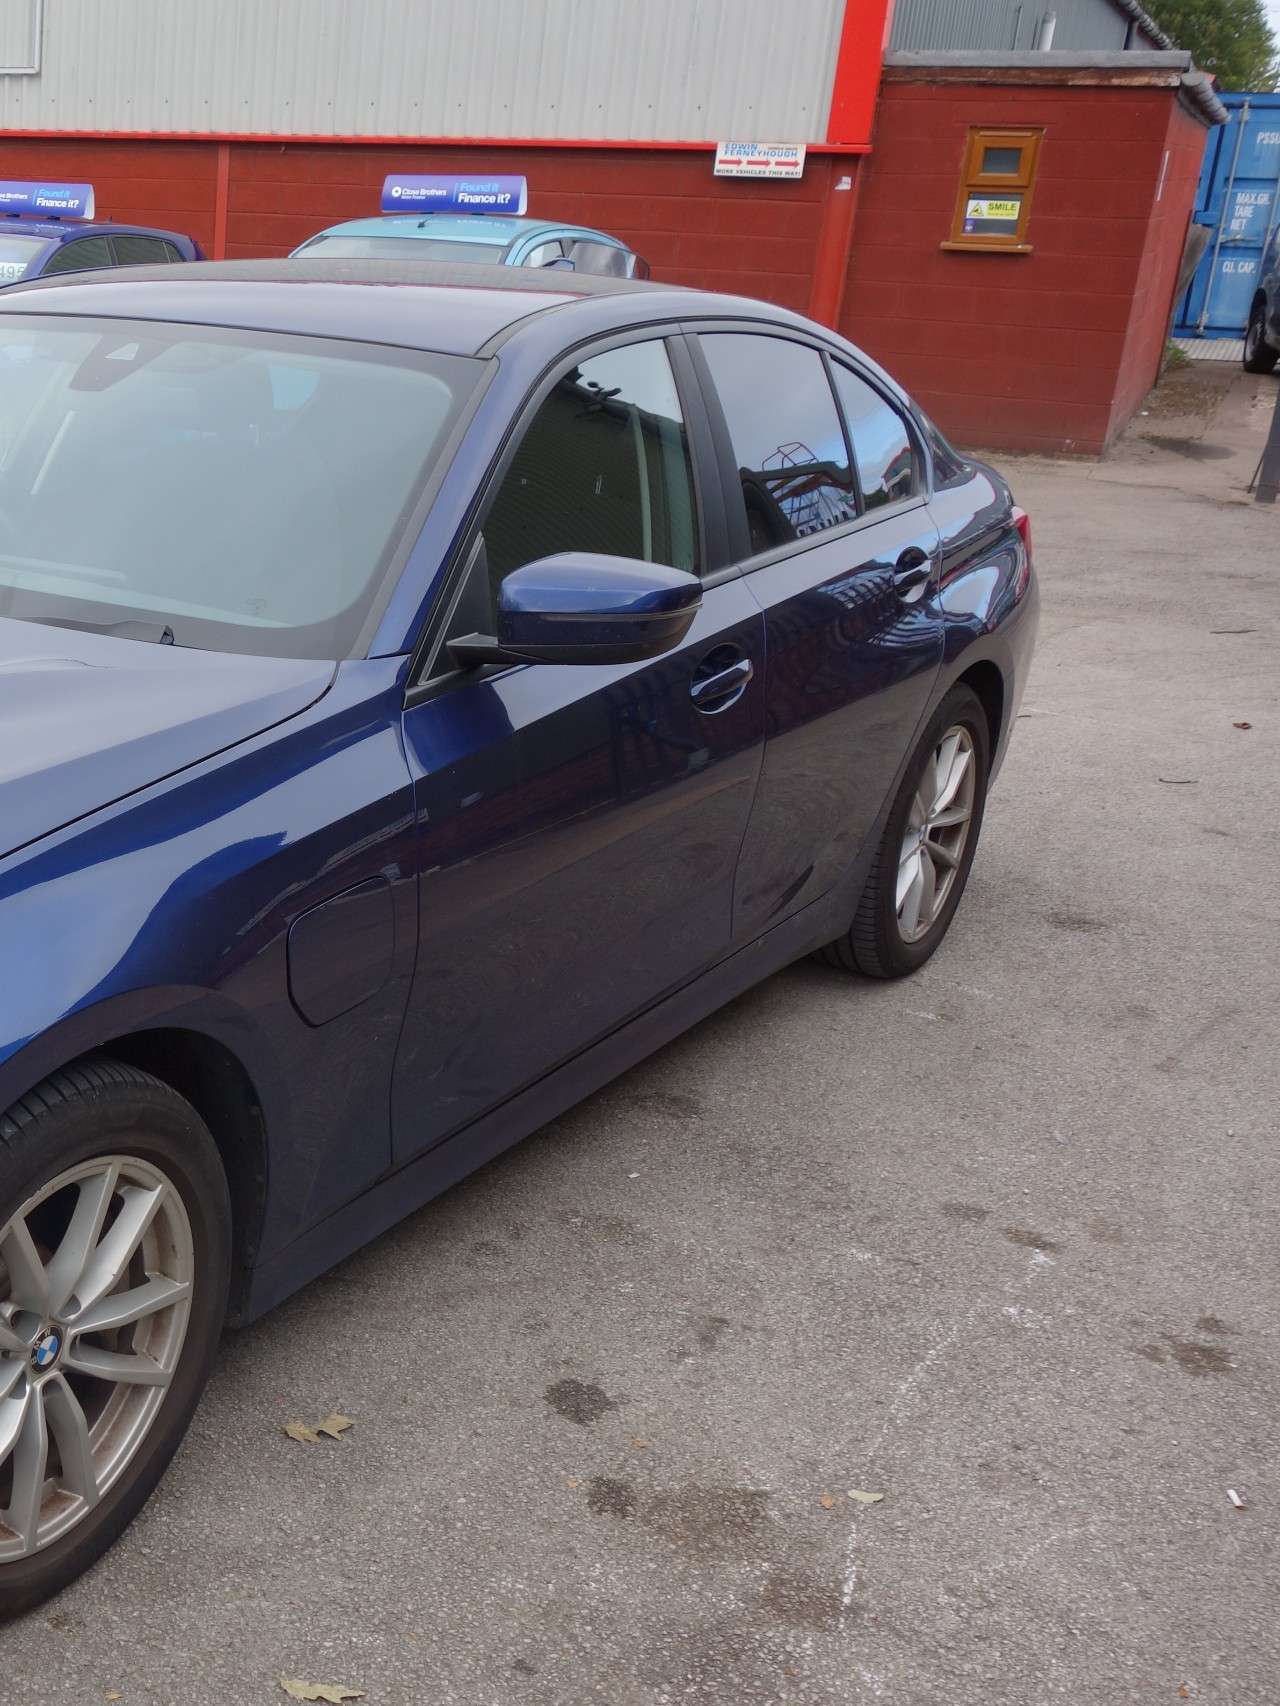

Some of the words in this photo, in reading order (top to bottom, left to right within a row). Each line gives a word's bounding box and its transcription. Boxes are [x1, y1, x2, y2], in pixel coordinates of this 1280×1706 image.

[724, 149, 798, 158] FERNEYHOUGH
[460, 182, 489, 192] Found
[39, 189, 61, 198] Found
[420, 188, 447, 197] Brothers
[36, 197, 67, 208] Finance
[68, 199, 80, 209] it?
[458, 192, 496, 203] Finance
[497, 193, 511, 204] it?
[988, 202, 1017, 211] SMILE
[1234, 205, 1254, 217] TARE
[1238, 262, 1256, 273] CAP.
